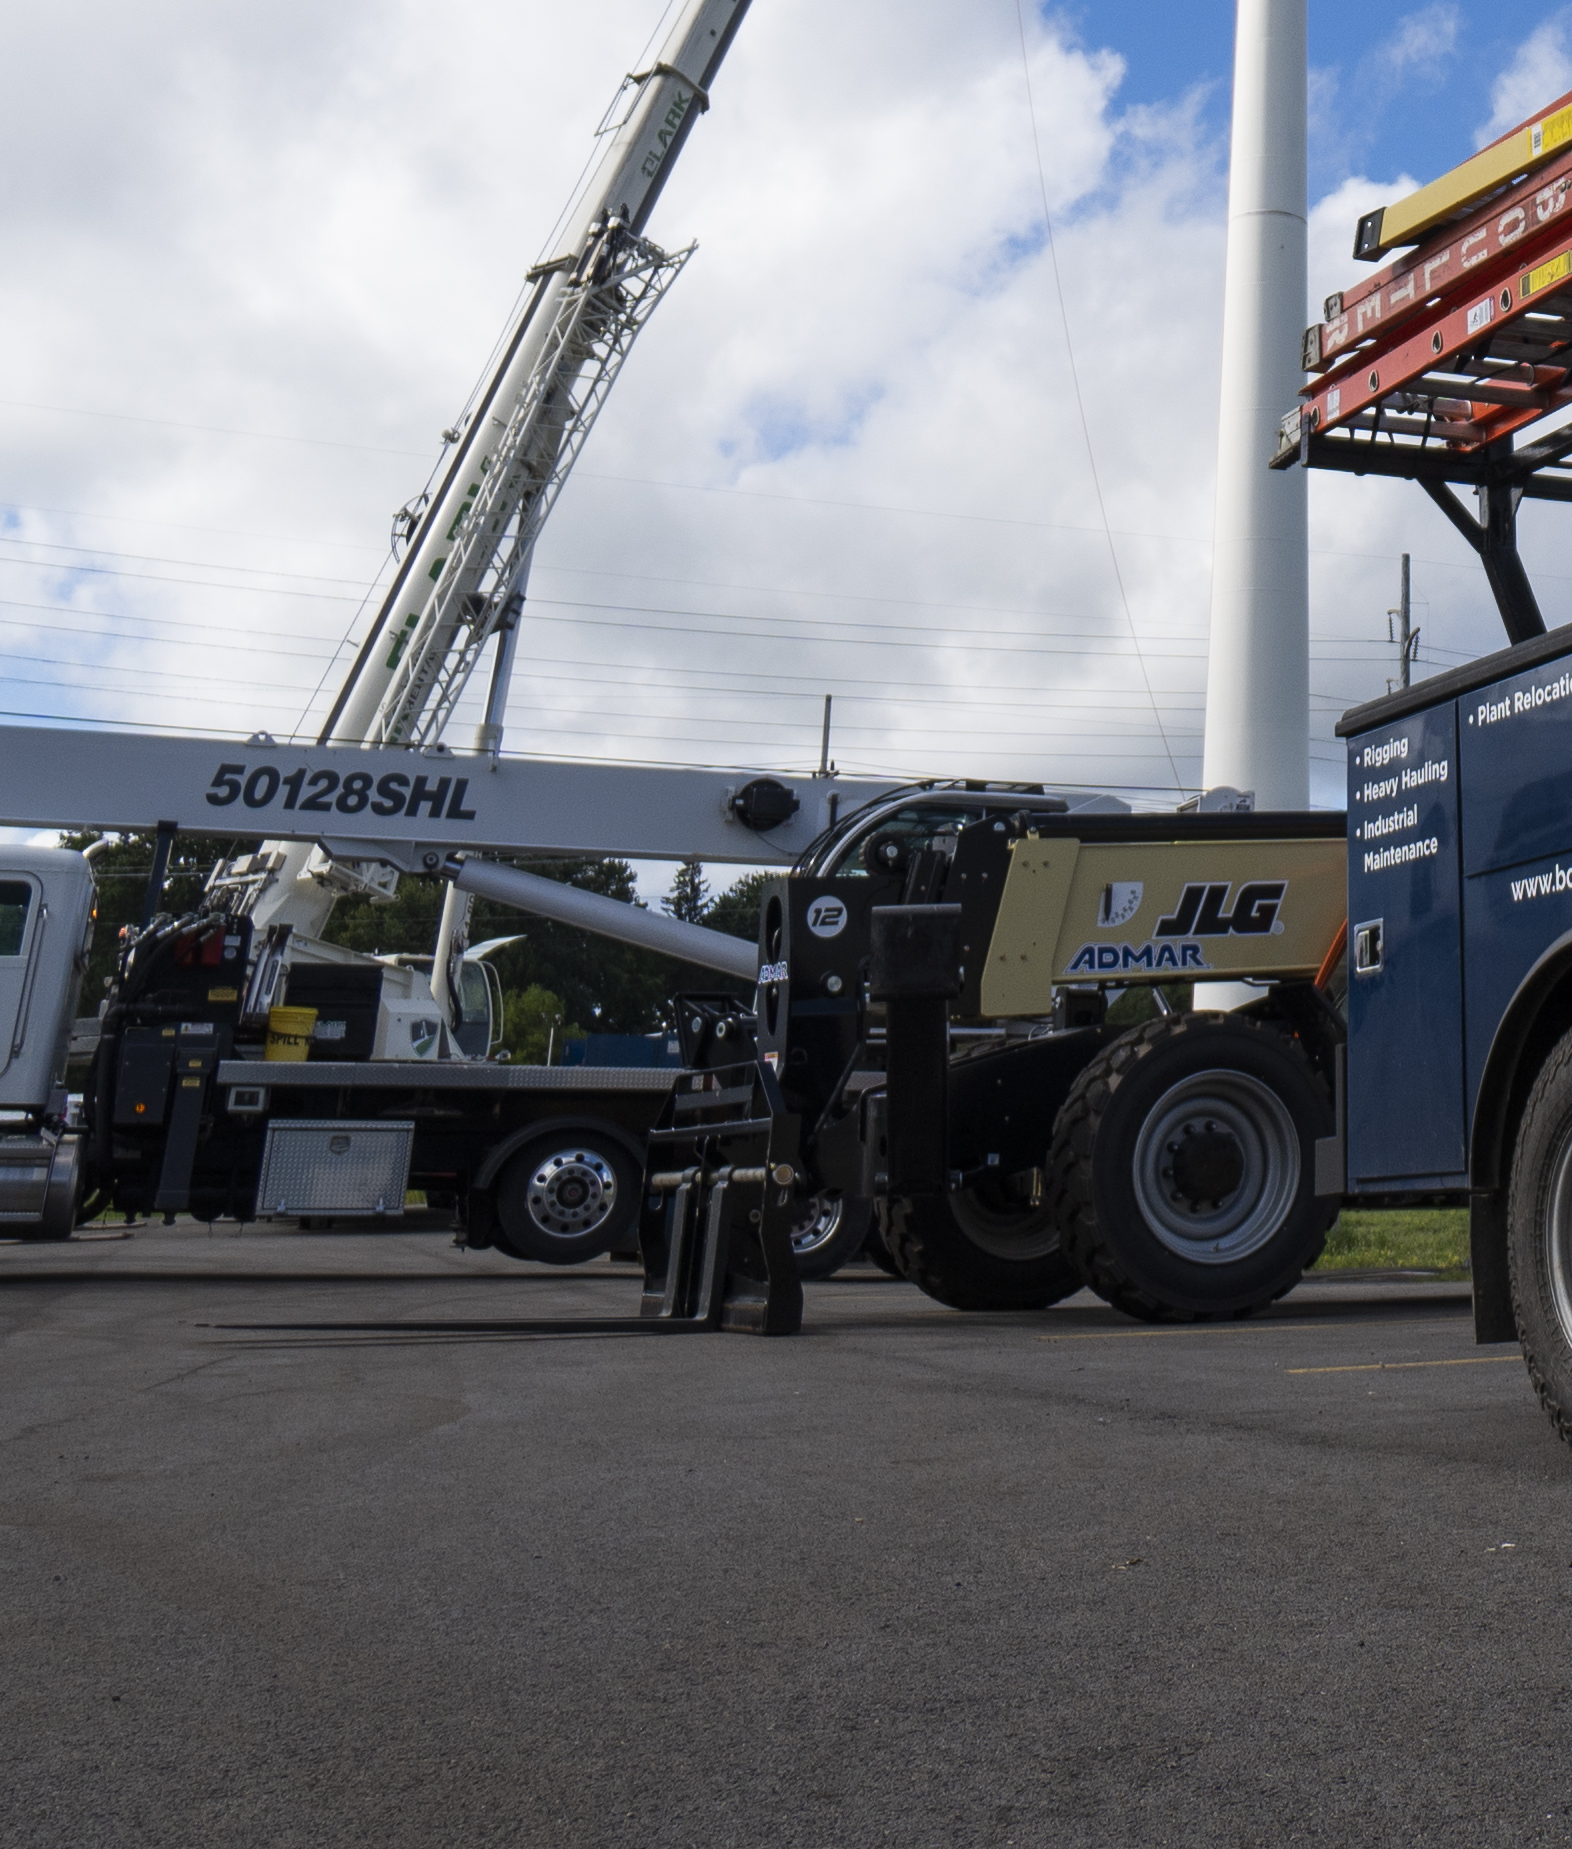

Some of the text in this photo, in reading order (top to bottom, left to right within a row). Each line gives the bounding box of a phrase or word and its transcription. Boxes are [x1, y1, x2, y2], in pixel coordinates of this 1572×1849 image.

[1478, 697, 1510, 726] Plant
[1364, 738, 1408, 767] Rigging
[205, 763, 477, 822] 50128SHL
[1364, 760, 1447, 802] Heavy Hauling
[1365, 804, 1417, 839] Industrial
[1365, 837, 1438, 872] Maintenance
[812, 907, 843, 926] 12
[1153, 880, 1288, 938] JLG
[1068, 941, 1207, 973] ADMAR
